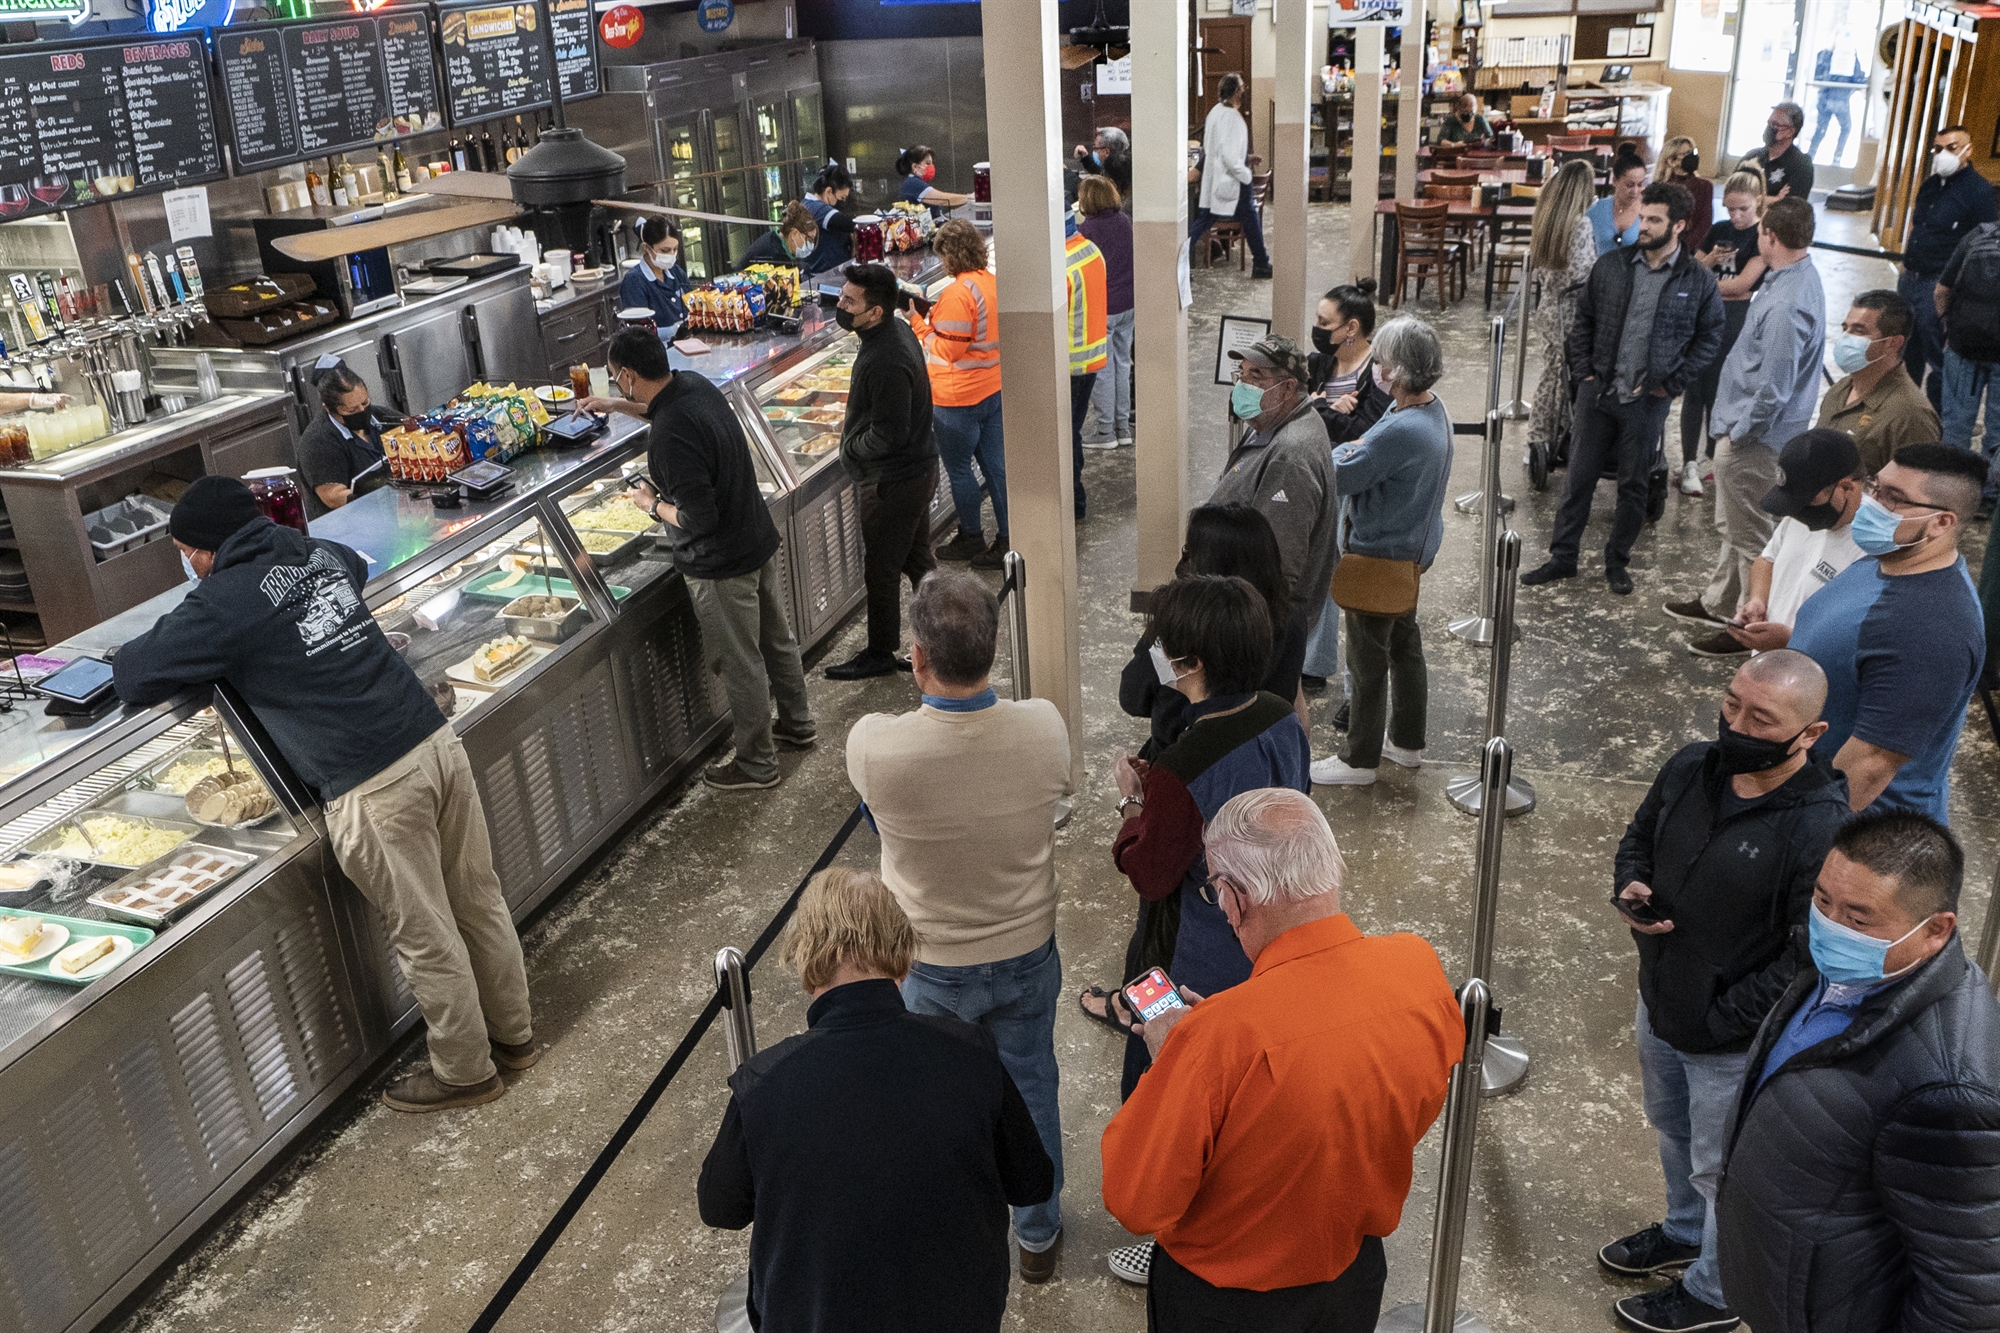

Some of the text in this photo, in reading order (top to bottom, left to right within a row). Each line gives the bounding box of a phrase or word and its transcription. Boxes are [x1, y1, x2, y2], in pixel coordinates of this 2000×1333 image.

[330, 26, 360, 41] SOUPS
[470, 20, 514, 35] SANDWICHES
[123, 42, 191, 64] BEVERAGES
[50, 53, 85, 71] REDS
[142, 171, 174, 184] Cold Brew
[444, 437, 460, 454] Fritos
[1816, 558, 1837, 580] VANS
[306, 634, 344, 656] Commitment
